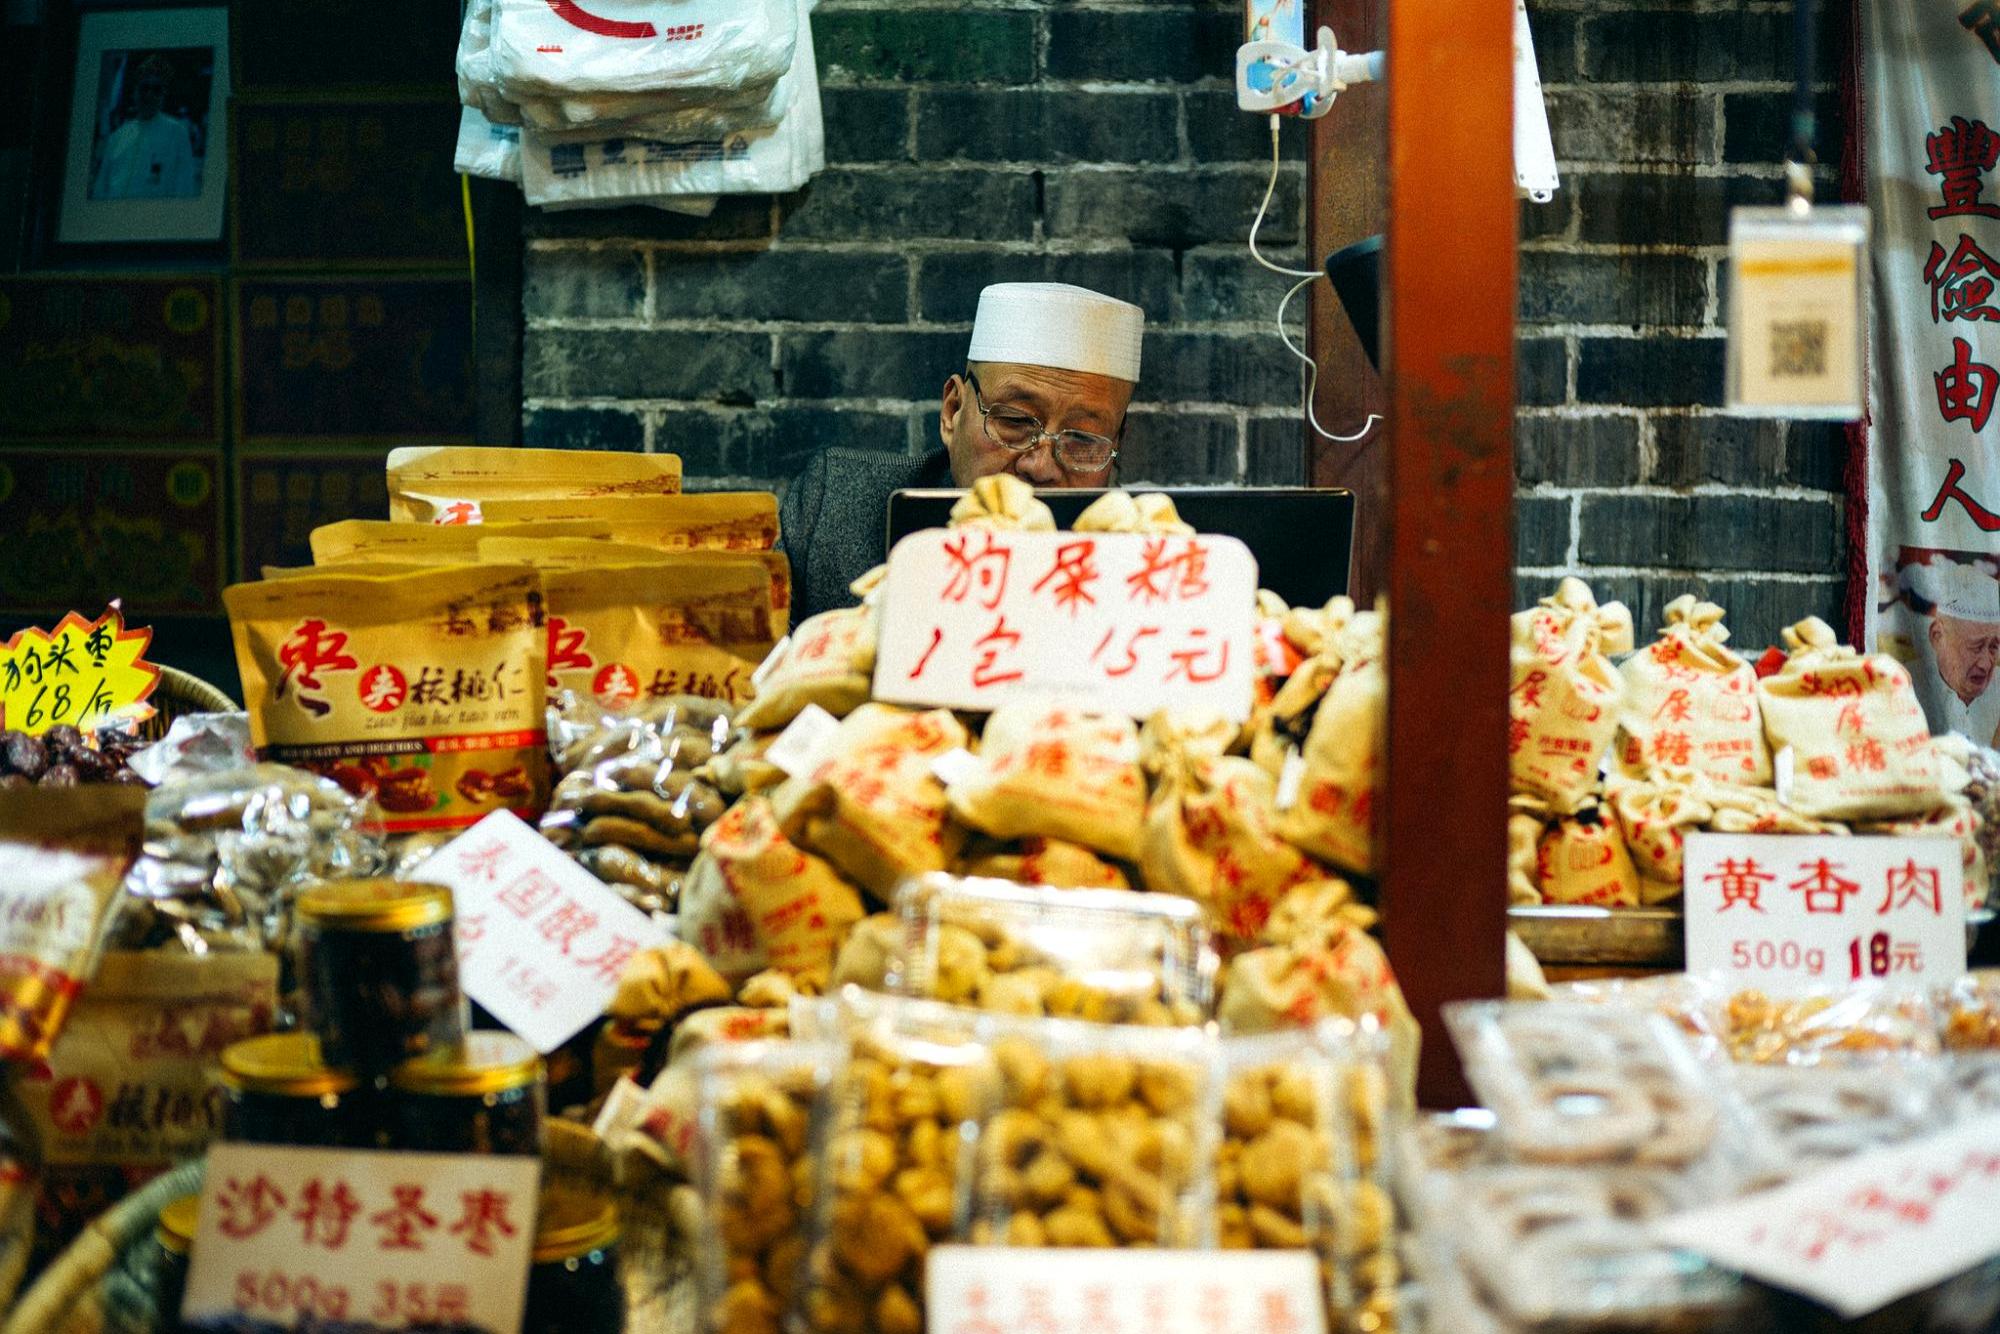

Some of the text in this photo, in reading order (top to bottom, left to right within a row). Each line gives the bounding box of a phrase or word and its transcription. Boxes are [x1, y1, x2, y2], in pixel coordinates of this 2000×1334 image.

[1921, 113, 2000, 533] 豐儉由人
[1090, 622, 1232, 684] 15元
[1702, 857, 1942, 916] 黄杏肉
[1731, 939, 1826, 976] 500g
[216, 1174, 518, 1256] 沙特圣枣
